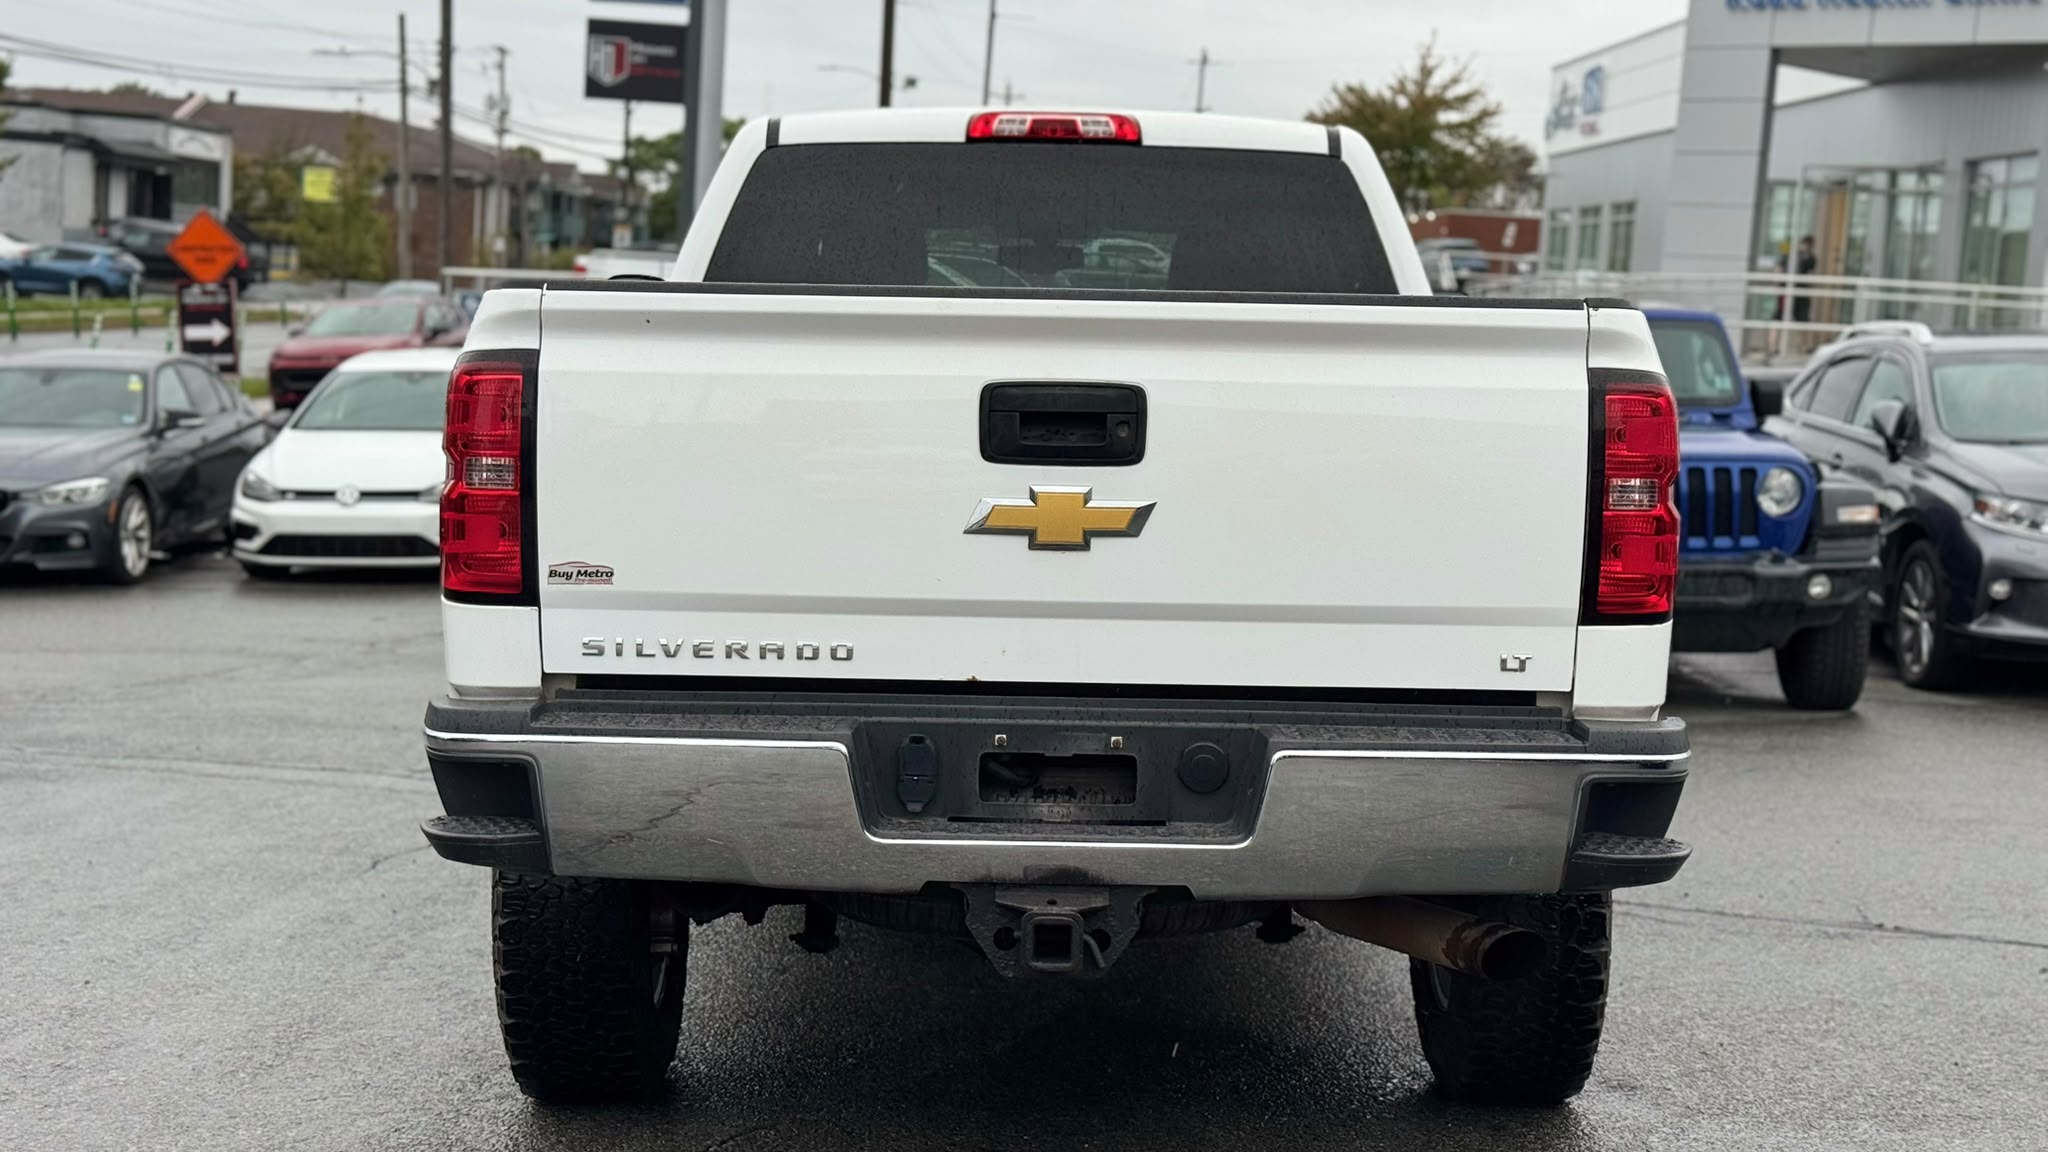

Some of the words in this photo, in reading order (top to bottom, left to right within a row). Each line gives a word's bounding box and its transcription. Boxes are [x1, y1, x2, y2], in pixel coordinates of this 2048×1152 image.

[549, 569, 573, 581] Buy
[576, 569, 614, 578] Metro
[582, 637, 854, 661] SILVERADO
[1500, 653, 1534, 673] LT
